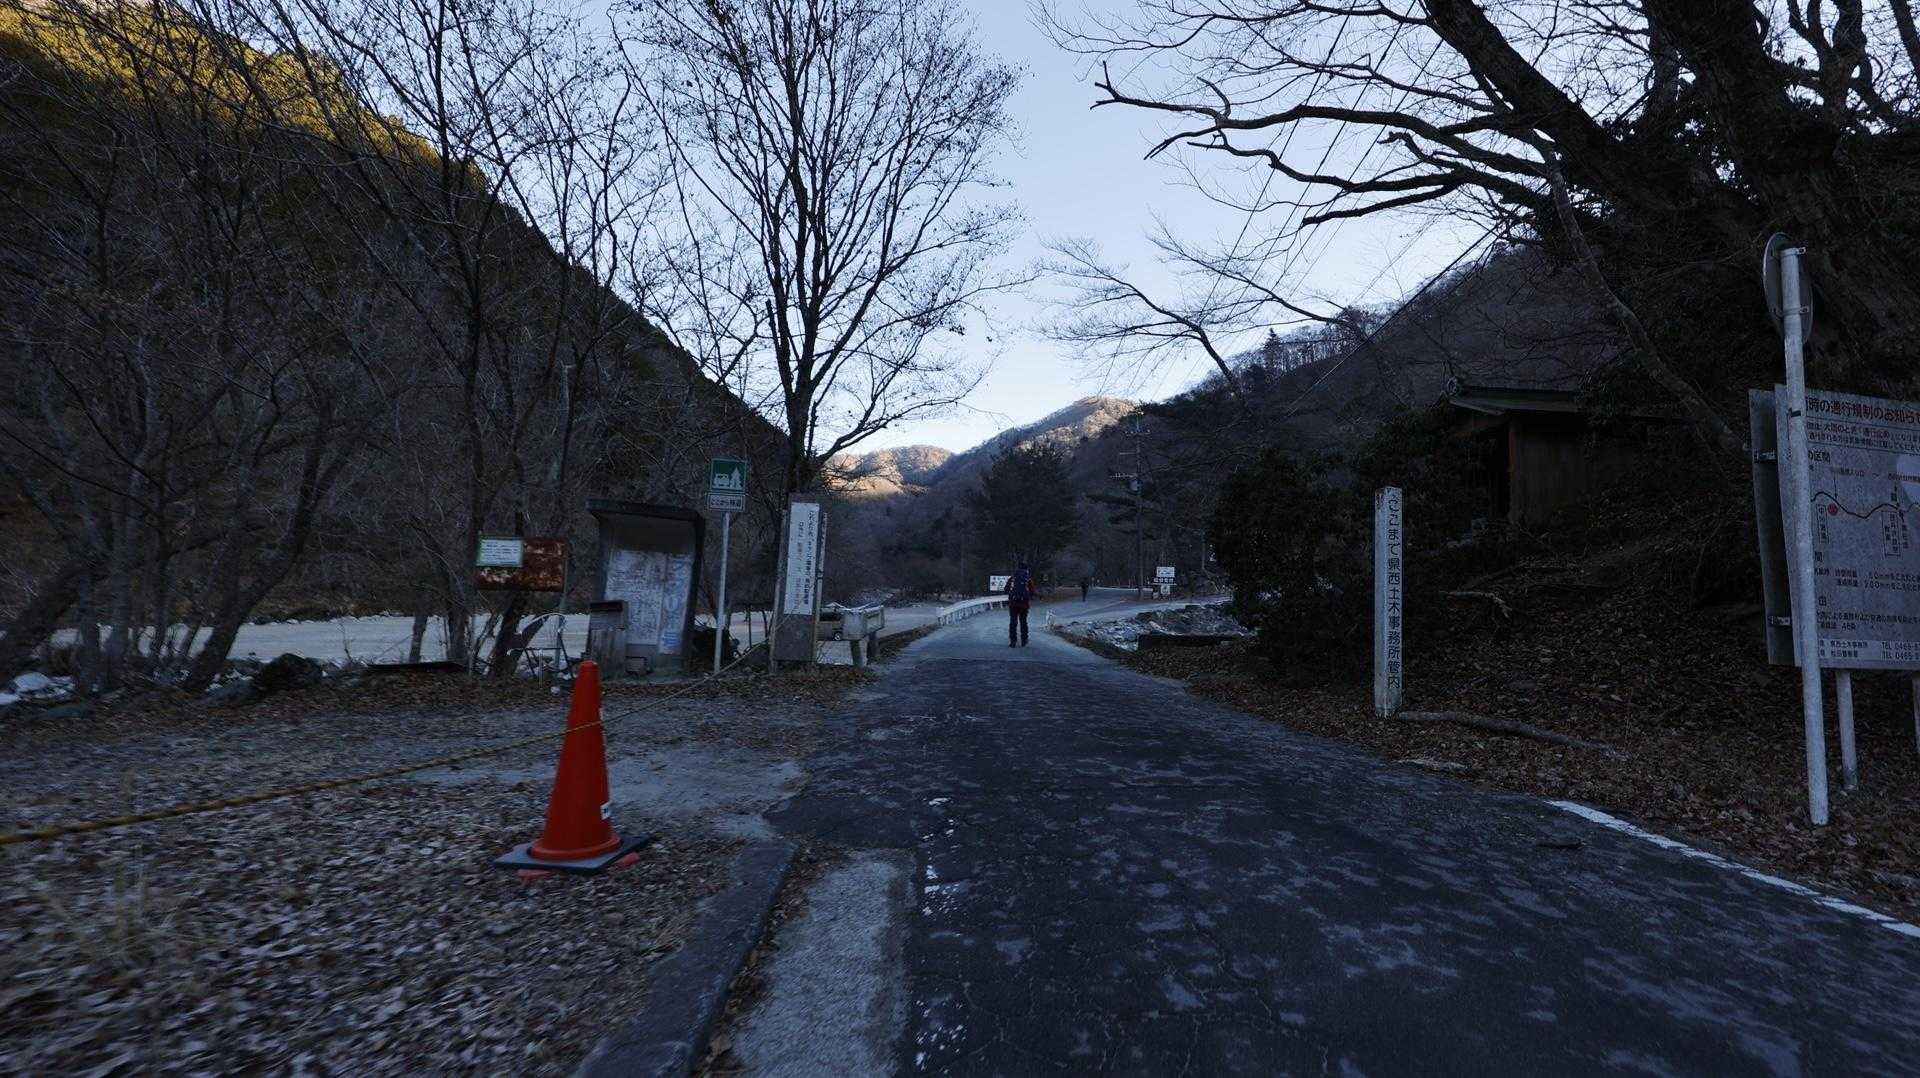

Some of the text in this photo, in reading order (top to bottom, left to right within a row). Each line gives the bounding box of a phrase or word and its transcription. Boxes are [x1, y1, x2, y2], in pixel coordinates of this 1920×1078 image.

[1387, 496, 1401, 689] ここまで県西土木事務所管内
